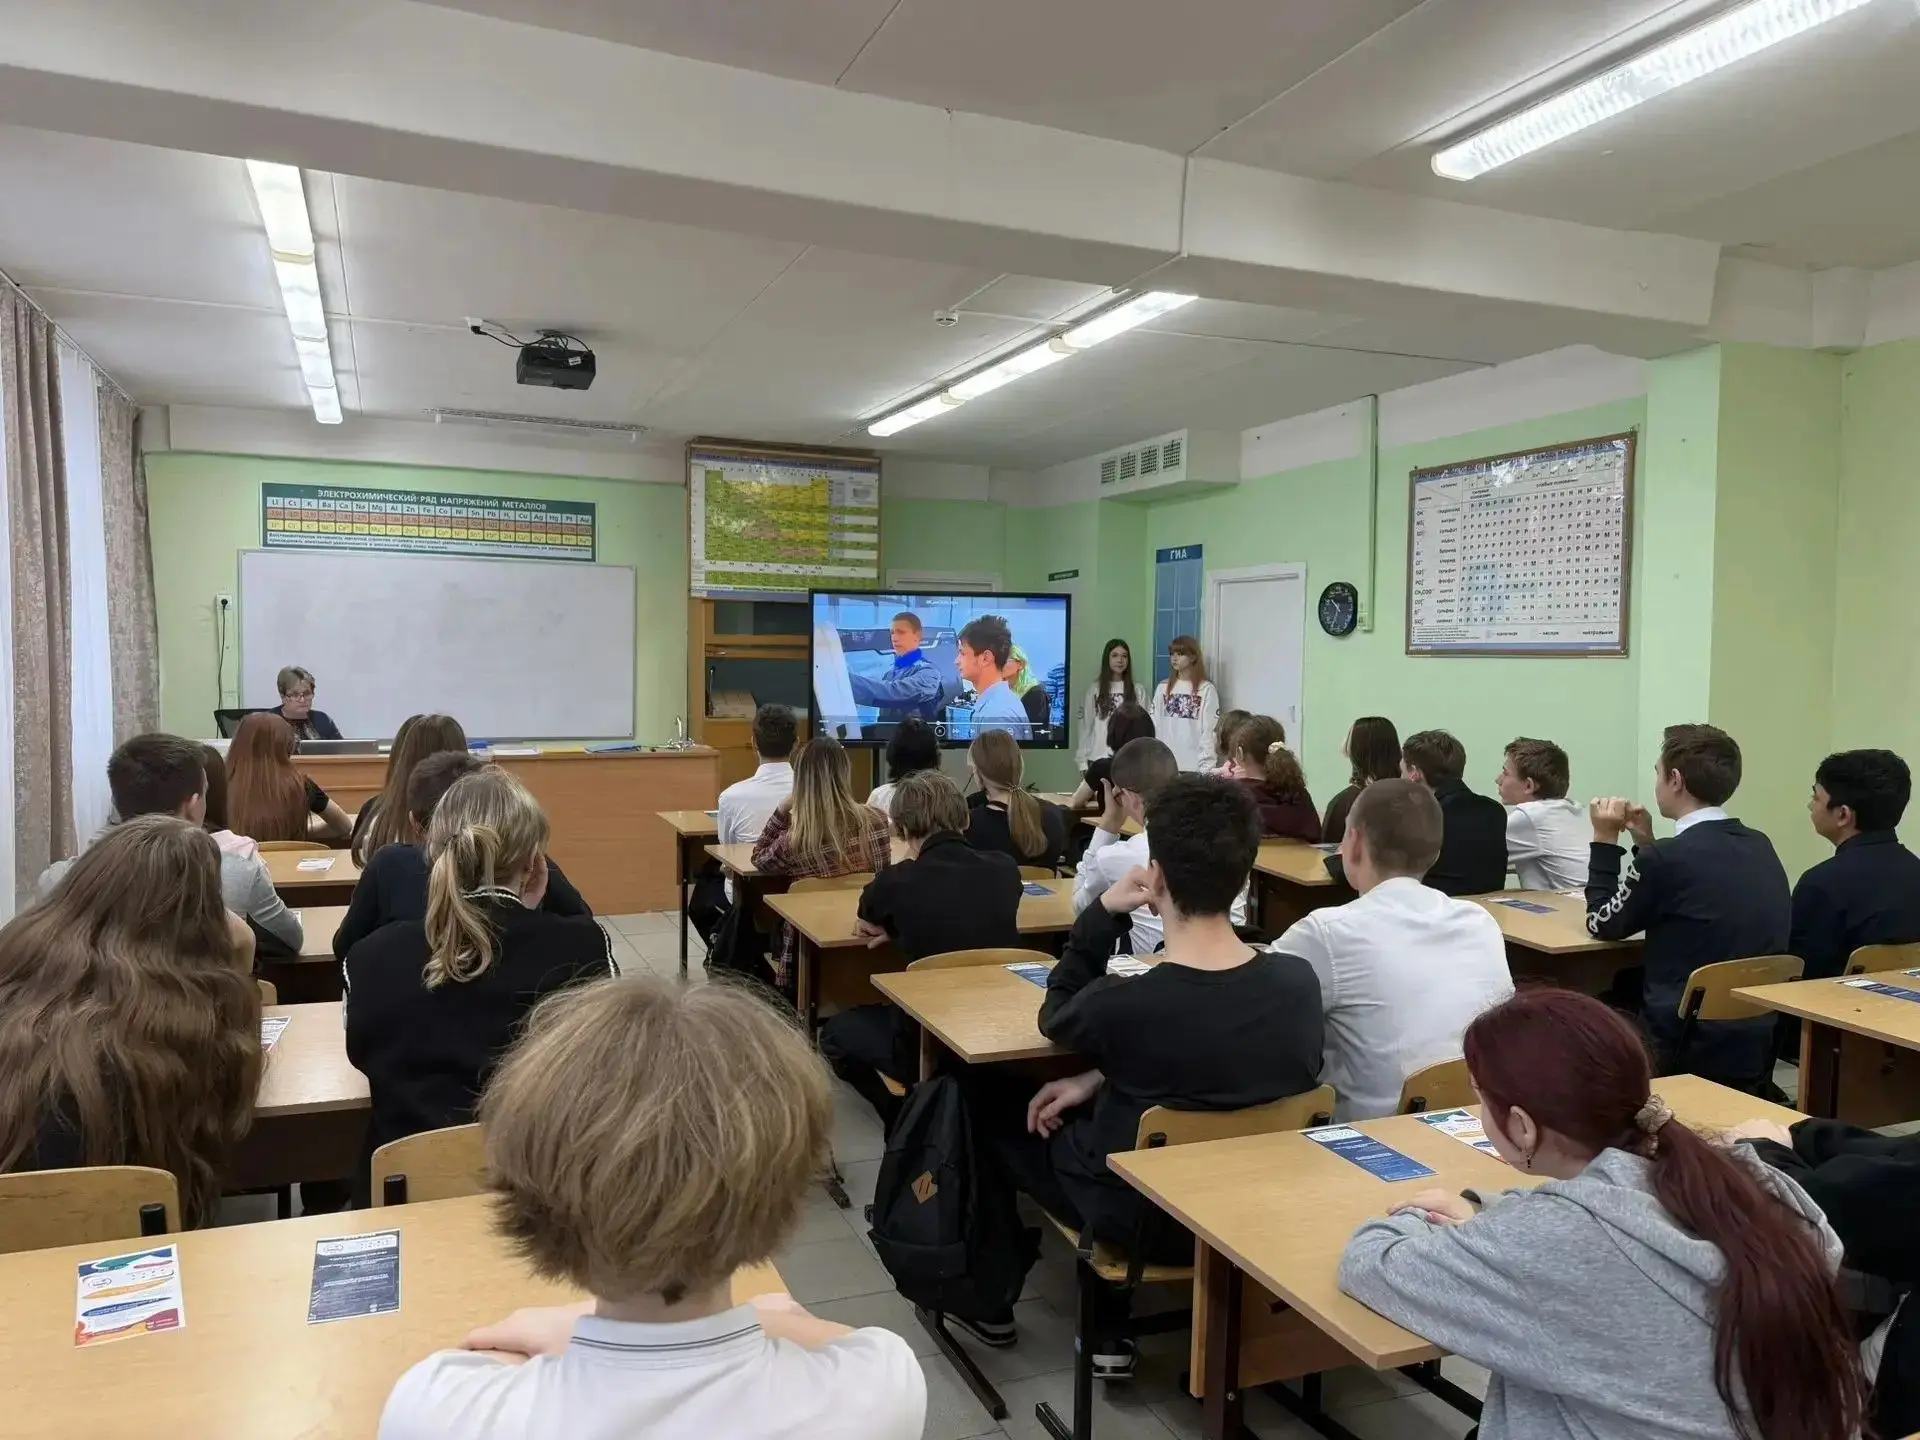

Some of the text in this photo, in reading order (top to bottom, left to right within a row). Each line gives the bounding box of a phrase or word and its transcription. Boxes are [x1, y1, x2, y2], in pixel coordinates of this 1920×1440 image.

[317, 490, 547, 510] ЭЛЕКТРОХИМИЧЕСКИЙ РЯД НАПРЯЖЕНИЙ МЕТАЛЛОВ
[1170, 548, 1187, 560] ГИА
